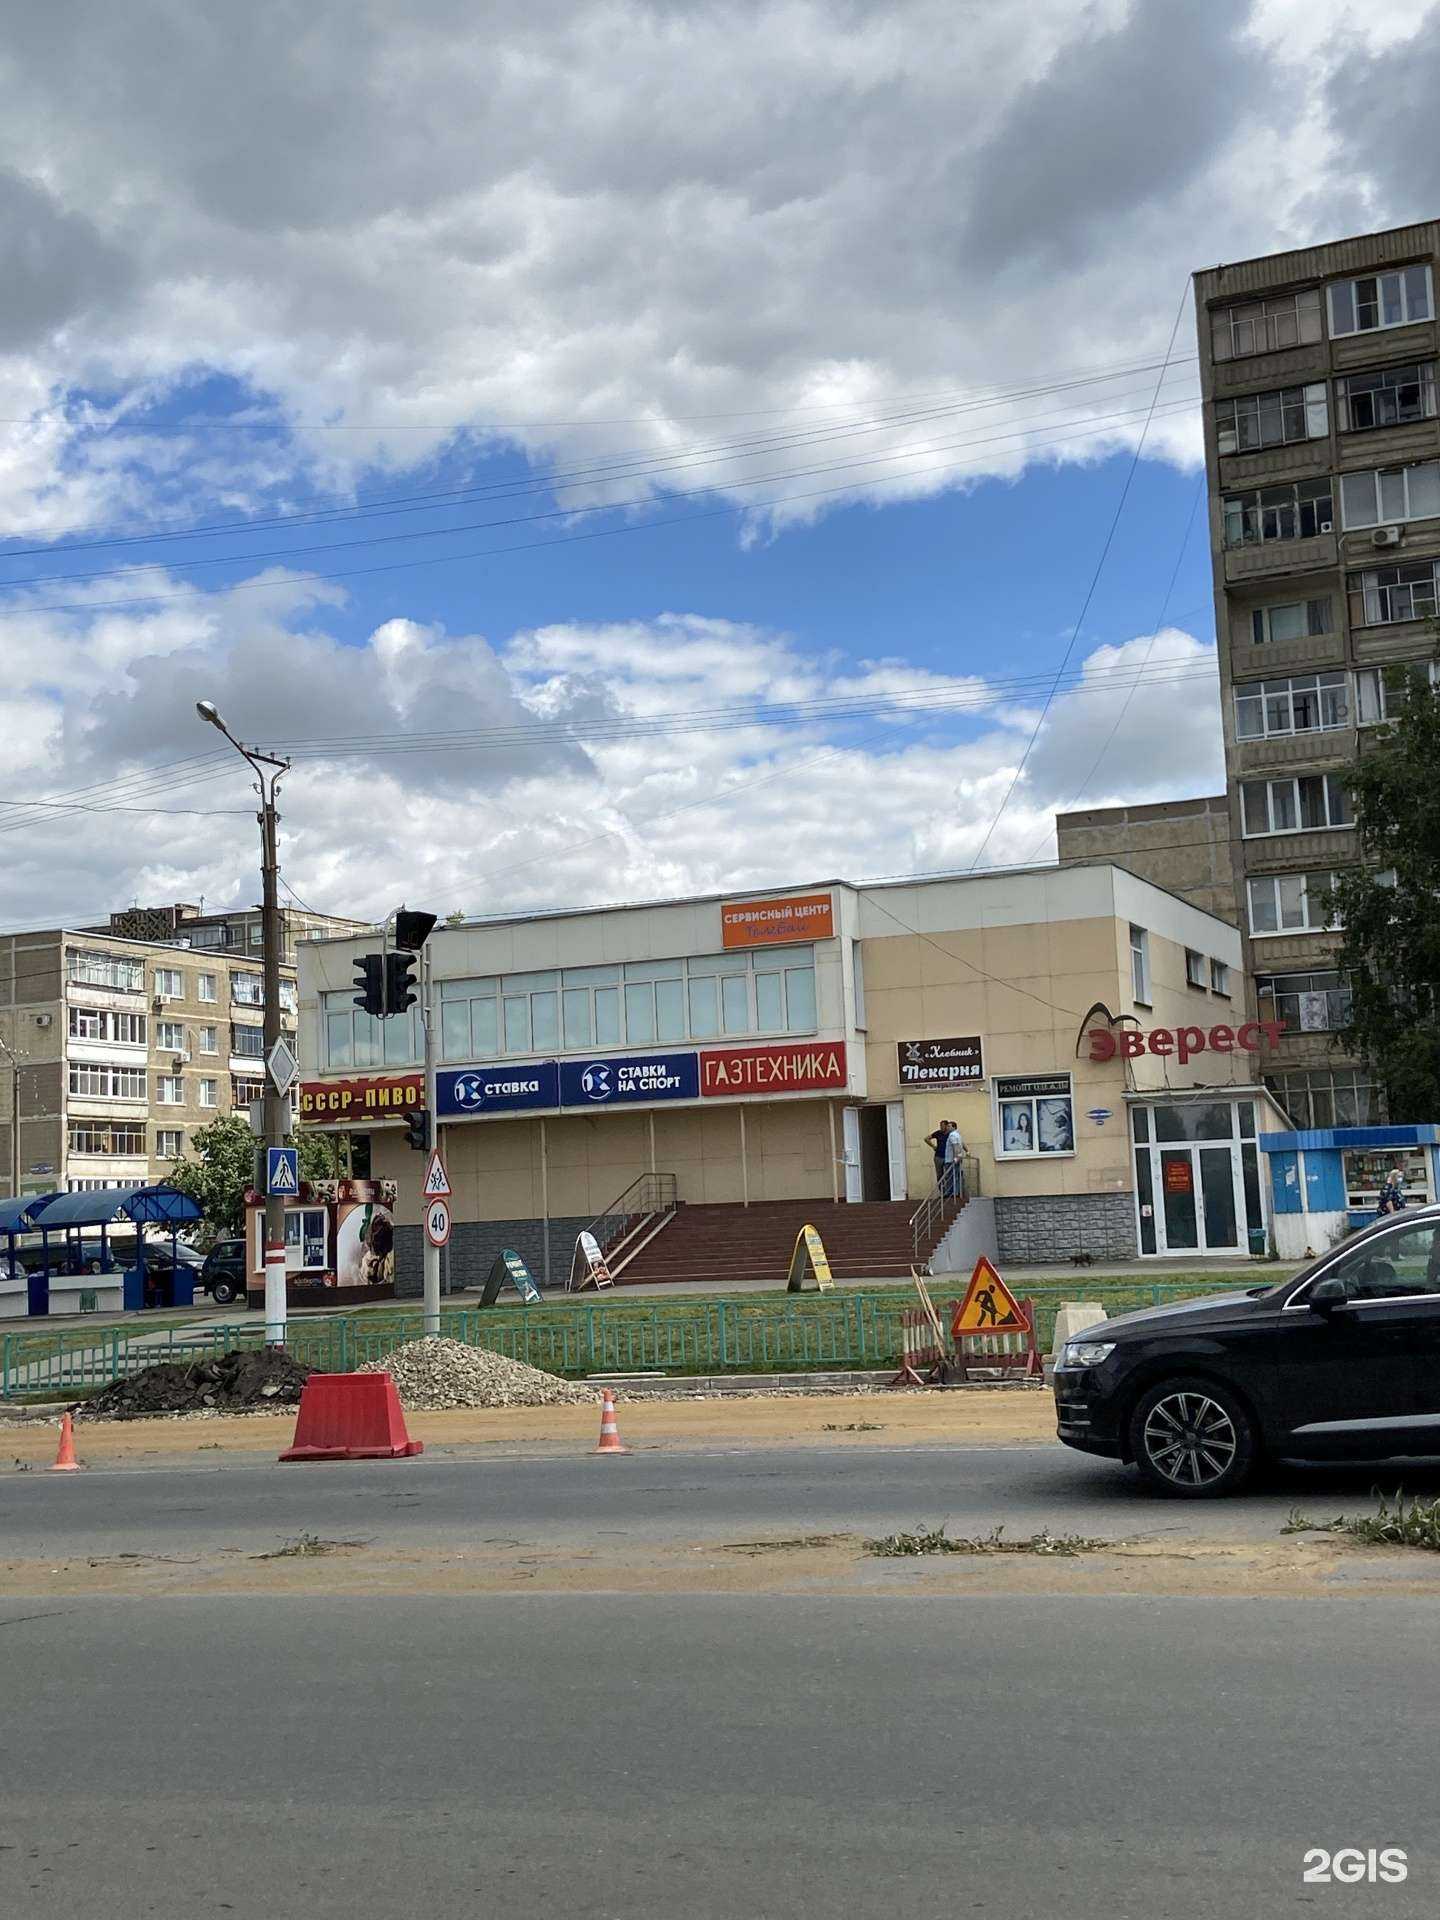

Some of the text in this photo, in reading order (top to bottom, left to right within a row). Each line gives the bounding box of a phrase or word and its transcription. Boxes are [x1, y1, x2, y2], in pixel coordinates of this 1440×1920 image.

[724, 904, 830, 924] СЕРВИСНЫЙ ЦЕНТР
[1088, 1021, 1286, 1064] Эверест
[618, 1065, 666, 1079] СТАВКИ
[704, 1052, 840, 1086] ГАЗТЕХНИКА
[902, 1065, 980, 1080] Пекарня
[618, 1076, 681, 1091] НА СПОРТ
[302, 1086, 417, 1112] СССР-ПИВО
[431, 1213, 446, 1231] 40
